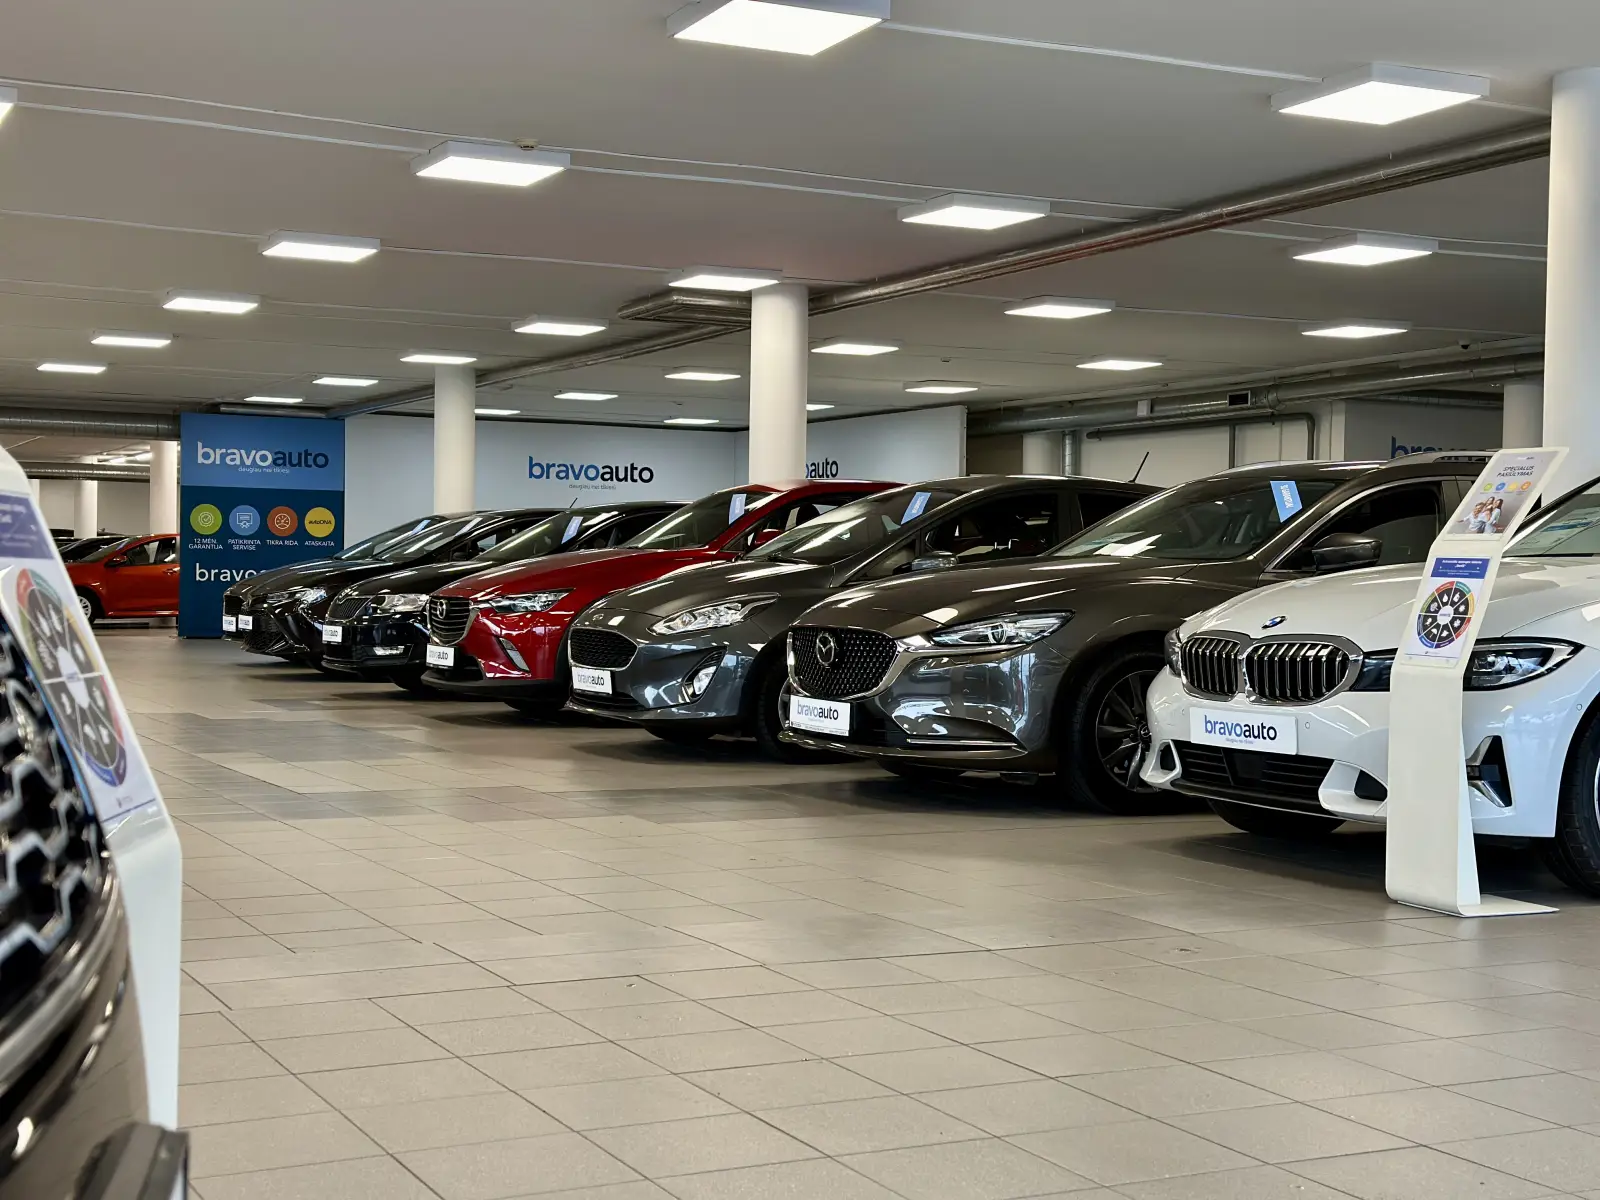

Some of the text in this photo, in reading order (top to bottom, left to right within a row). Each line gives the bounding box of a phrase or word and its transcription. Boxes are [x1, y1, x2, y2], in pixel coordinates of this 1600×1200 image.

[197, 441, 329, 469] bravoauto
[528, 455, 654, 483] bravoauto
[577, 671, 605, 686] bravoauto
[797, 699, 839, 721] bravoauto
[1204, 714, 1278, 741] bravoauto
